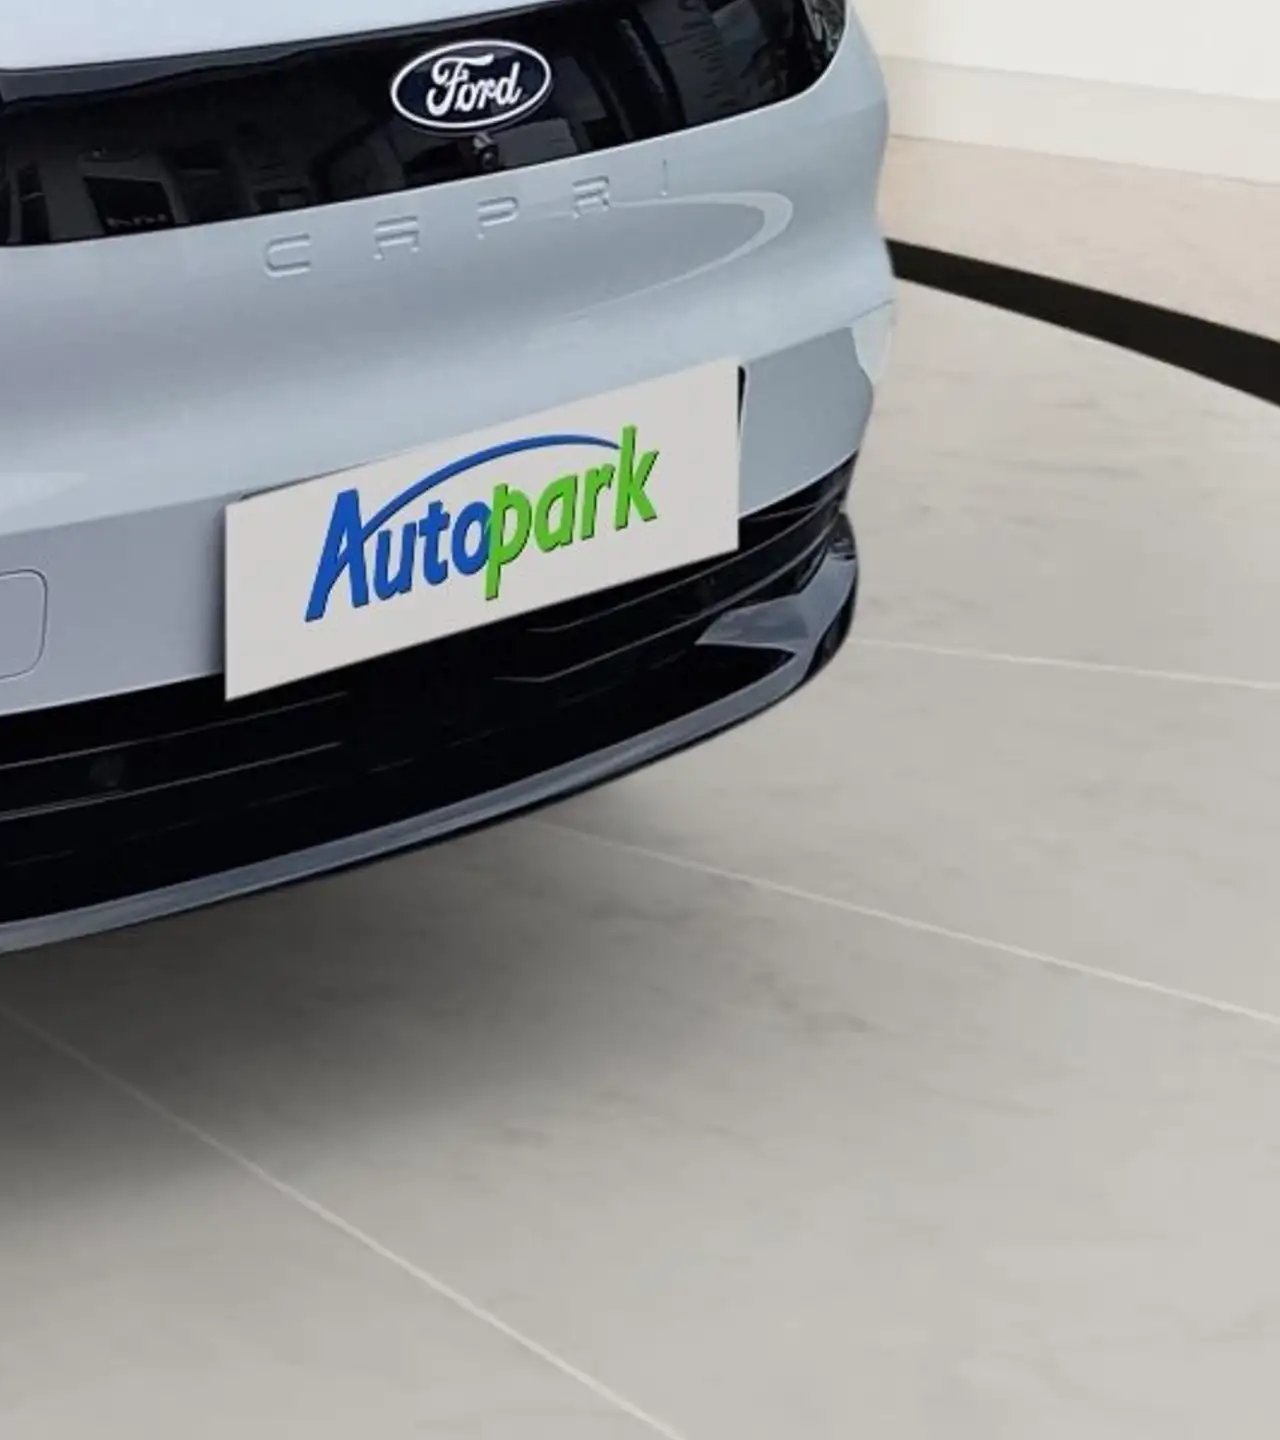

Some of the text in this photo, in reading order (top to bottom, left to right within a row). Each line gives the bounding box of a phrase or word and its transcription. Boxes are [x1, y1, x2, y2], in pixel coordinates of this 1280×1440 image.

[426, 54, 522, 116] Ford
[264, 159, 668, 278] CAPRI
[305, 426, 659, 622] Autopark
